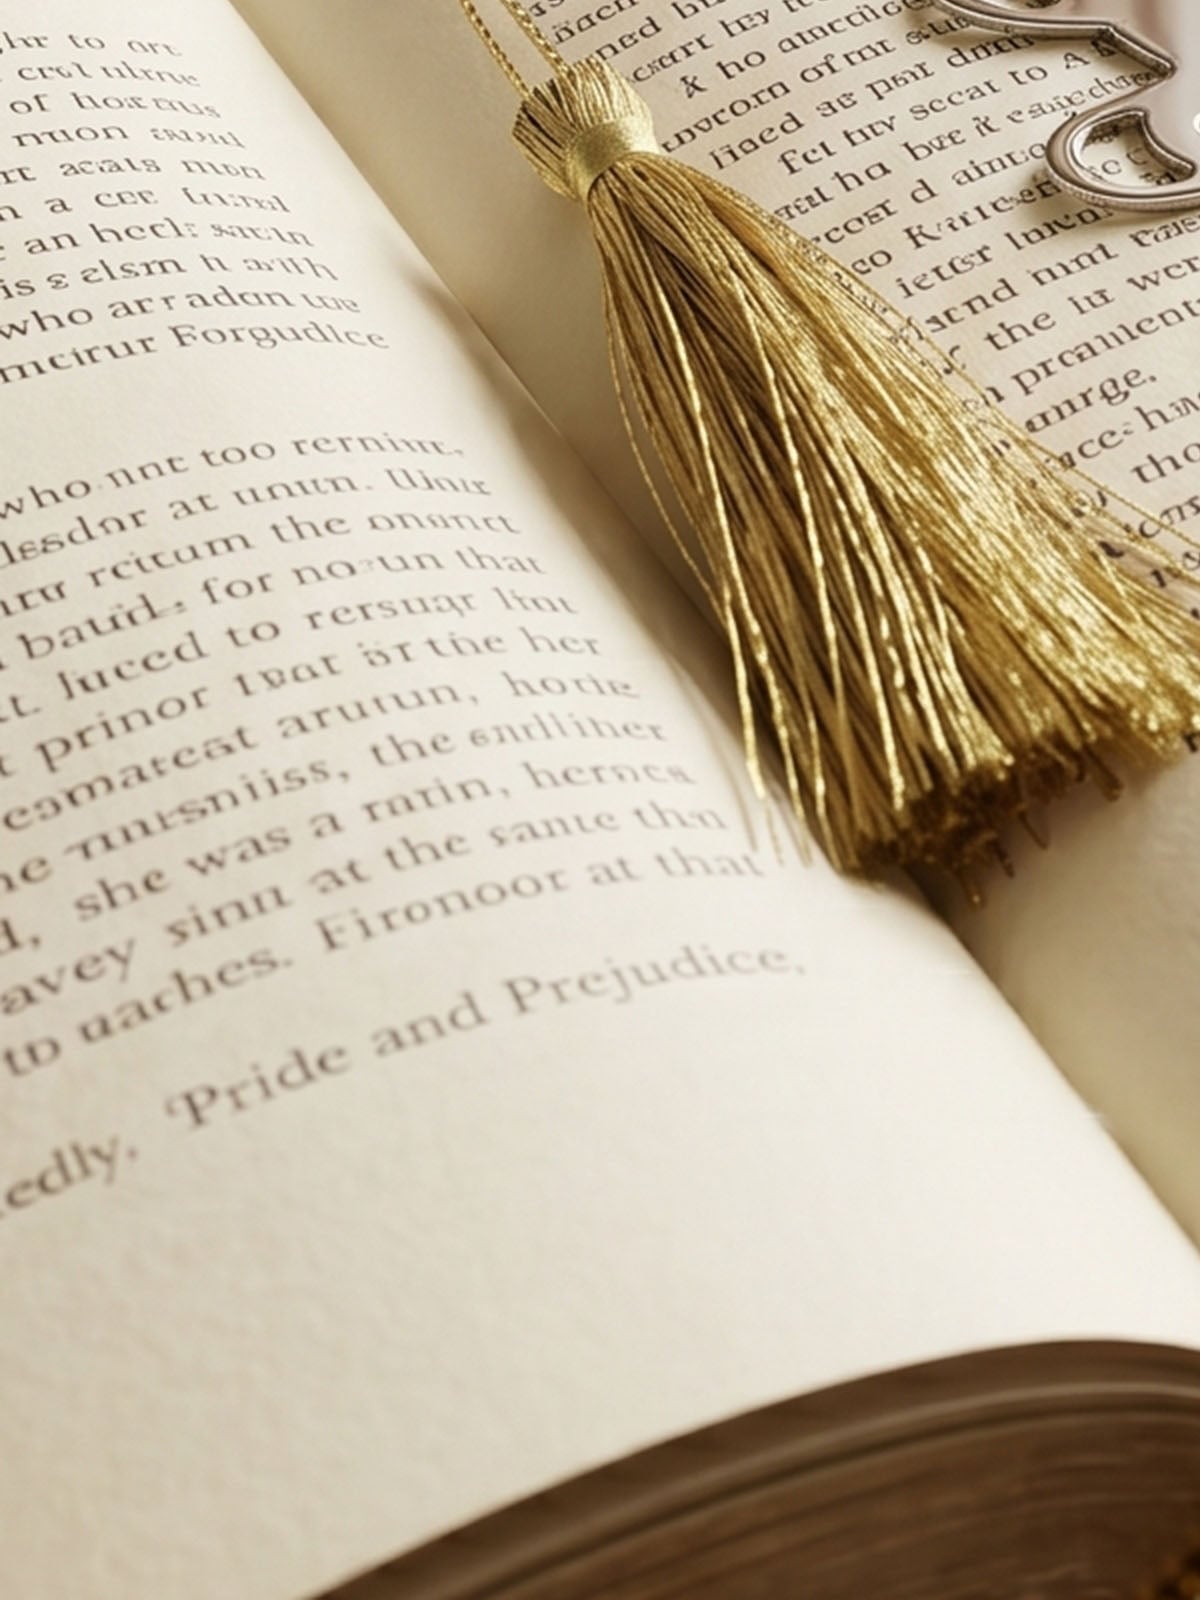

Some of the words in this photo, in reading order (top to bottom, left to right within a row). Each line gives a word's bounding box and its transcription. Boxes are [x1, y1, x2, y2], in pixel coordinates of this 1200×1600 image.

[43, 197, 73, 215] a
[23, 232, 81, 255] an
[983, 311, 1057, 352] the
[199, 442, 276, 468] too
[168, 494, 219, 521] at
[269, 514, 351, 543] the
[201, 573, 272, 605] for
[225, 621, 281, 648] to
[34, 686, 208, 775] prinor
[369, 734, 451, 766] the
[74, 869, 167, 921] she
[185, 827, 292, 876] was
[309, 812, 344, 839] a
[309, 859, 369, 894] at
[382, 834, 470, 873] the
[587, 857, 639, 886] at
[371, 989, 488, 1058] and
